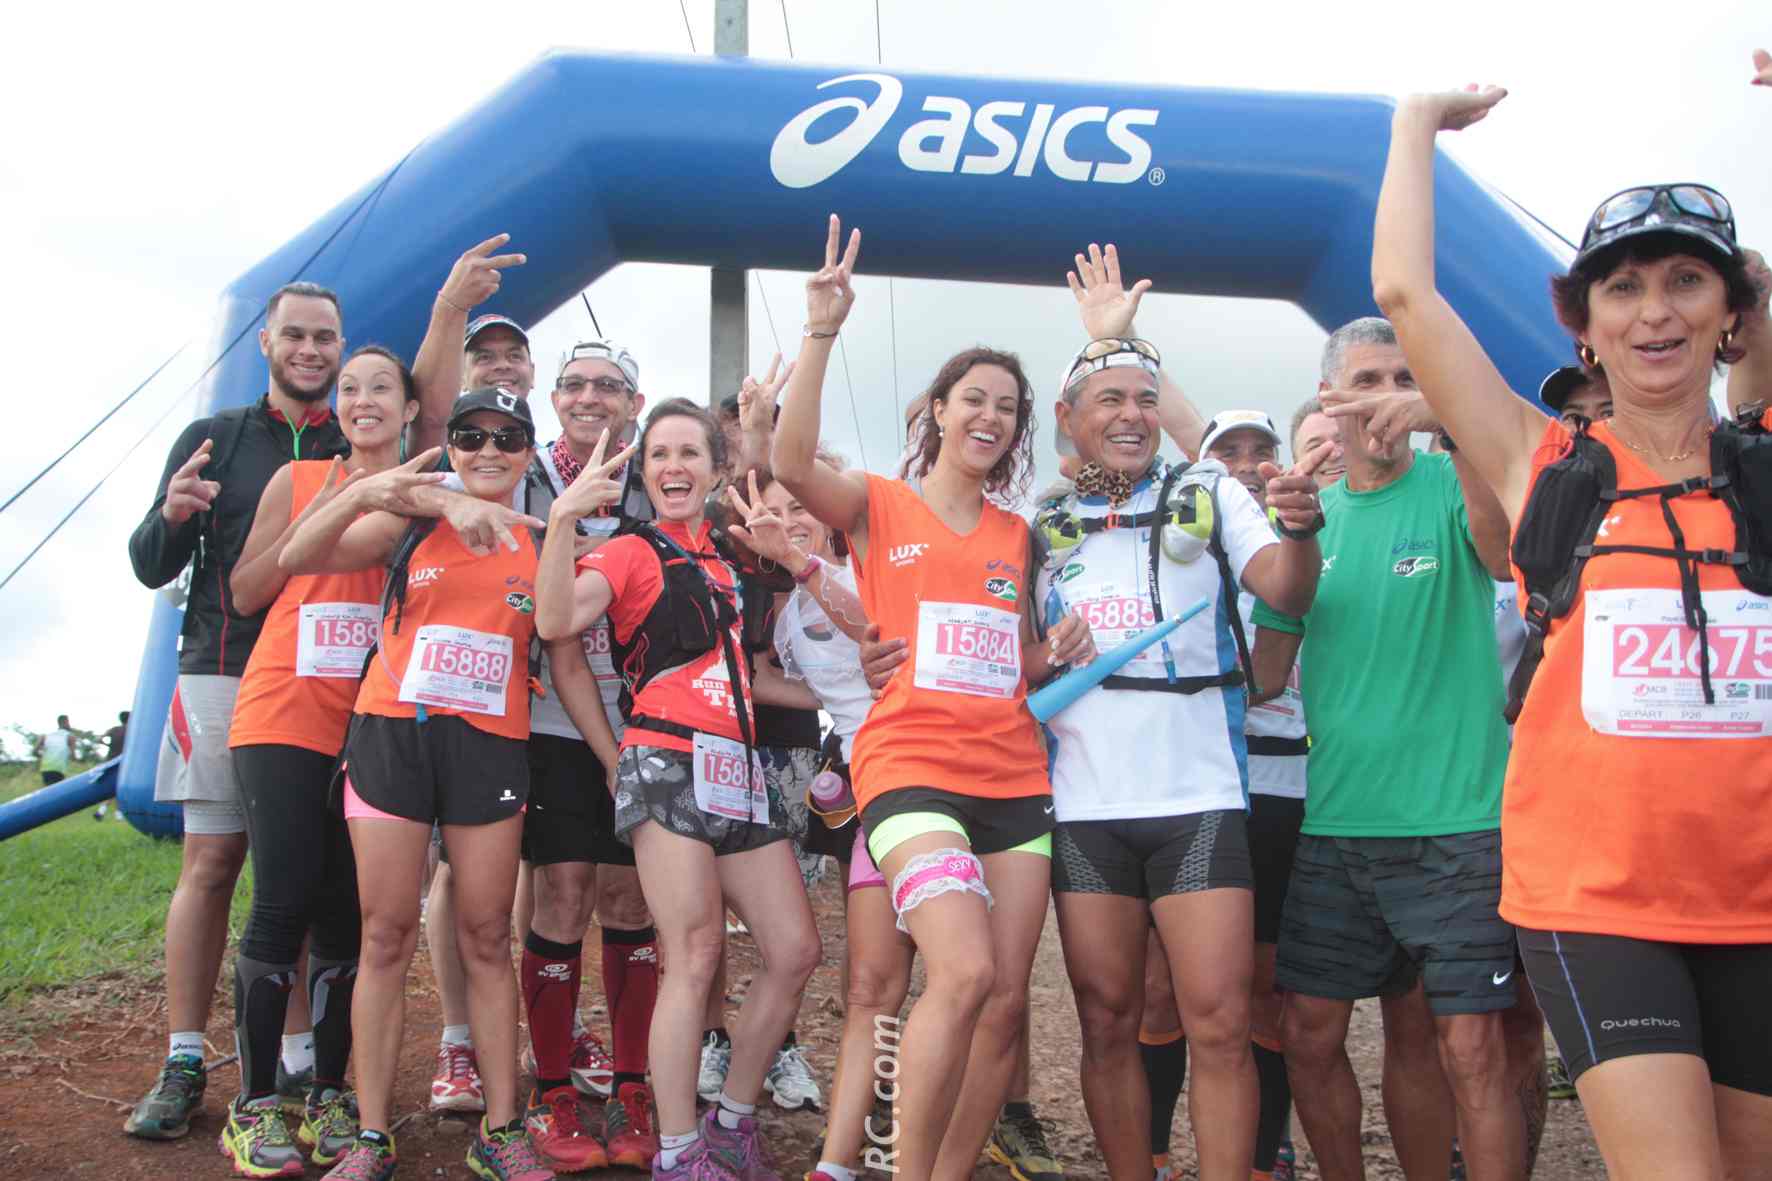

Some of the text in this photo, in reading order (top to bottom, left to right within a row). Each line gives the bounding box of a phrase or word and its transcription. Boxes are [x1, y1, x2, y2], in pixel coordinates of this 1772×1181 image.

[888, 544, 923, 562] LUX
[944, 625, 1014, 663] 15884
[427, 645, 505, 681] 15888
[1600, 1016, 1681, 1030] Quechua
